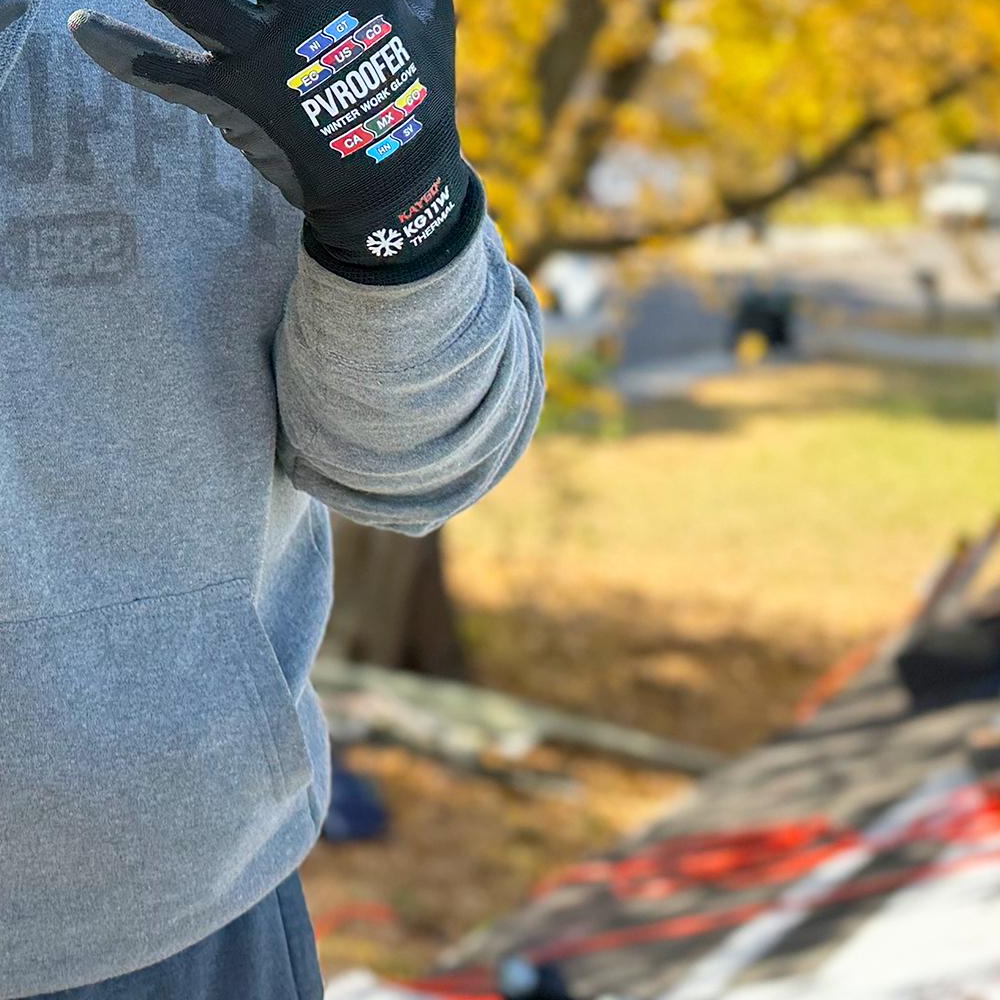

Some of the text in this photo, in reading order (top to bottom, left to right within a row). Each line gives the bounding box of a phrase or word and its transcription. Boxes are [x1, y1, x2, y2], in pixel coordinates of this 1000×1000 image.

[310, 20, 348, 52] NI GT
[334, 47, 352, 62] US
[366, 24, 382, 40] CO
[301, 35, 411, 127] PVROOFER
[320, 62, 417, 137] WINTER WORK GLOVE
[344, 134, 363, 149] CA
[376, 112, 395, 130] MX
[402, 185, 449, 238] KG11W
[409, 201, 455, 247] THERMAL
